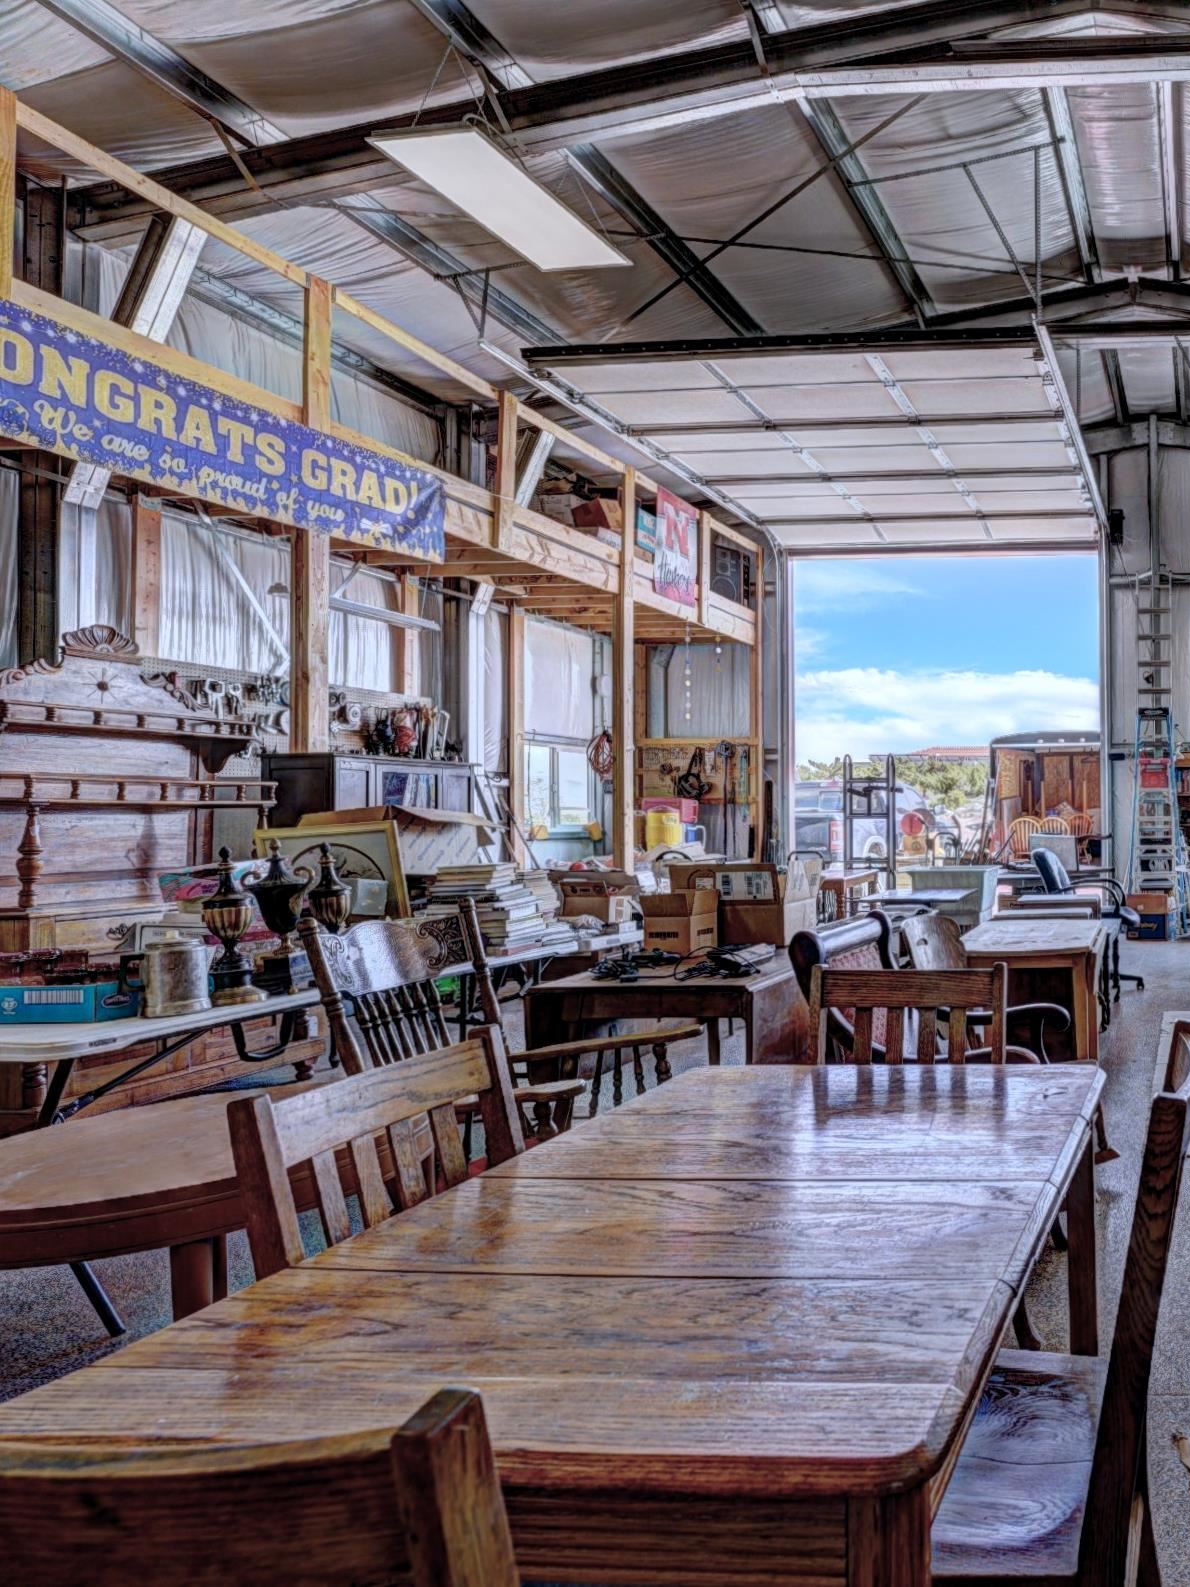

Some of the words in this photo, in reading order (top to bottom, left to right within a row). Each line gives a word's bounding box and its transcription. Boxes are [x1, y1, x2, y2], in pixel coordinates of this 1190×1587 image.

[33, 399, 94, 441] We
[101, 434, 150, 461] are
[158, 449, 188, 473] so
[200, 466, 269, 499] proud
[276, 487, 299, 512] of
[307, 499, 345, 521] you
[301, 449, 418, 519] GRAD!
[663, 501, 690, 561] N
